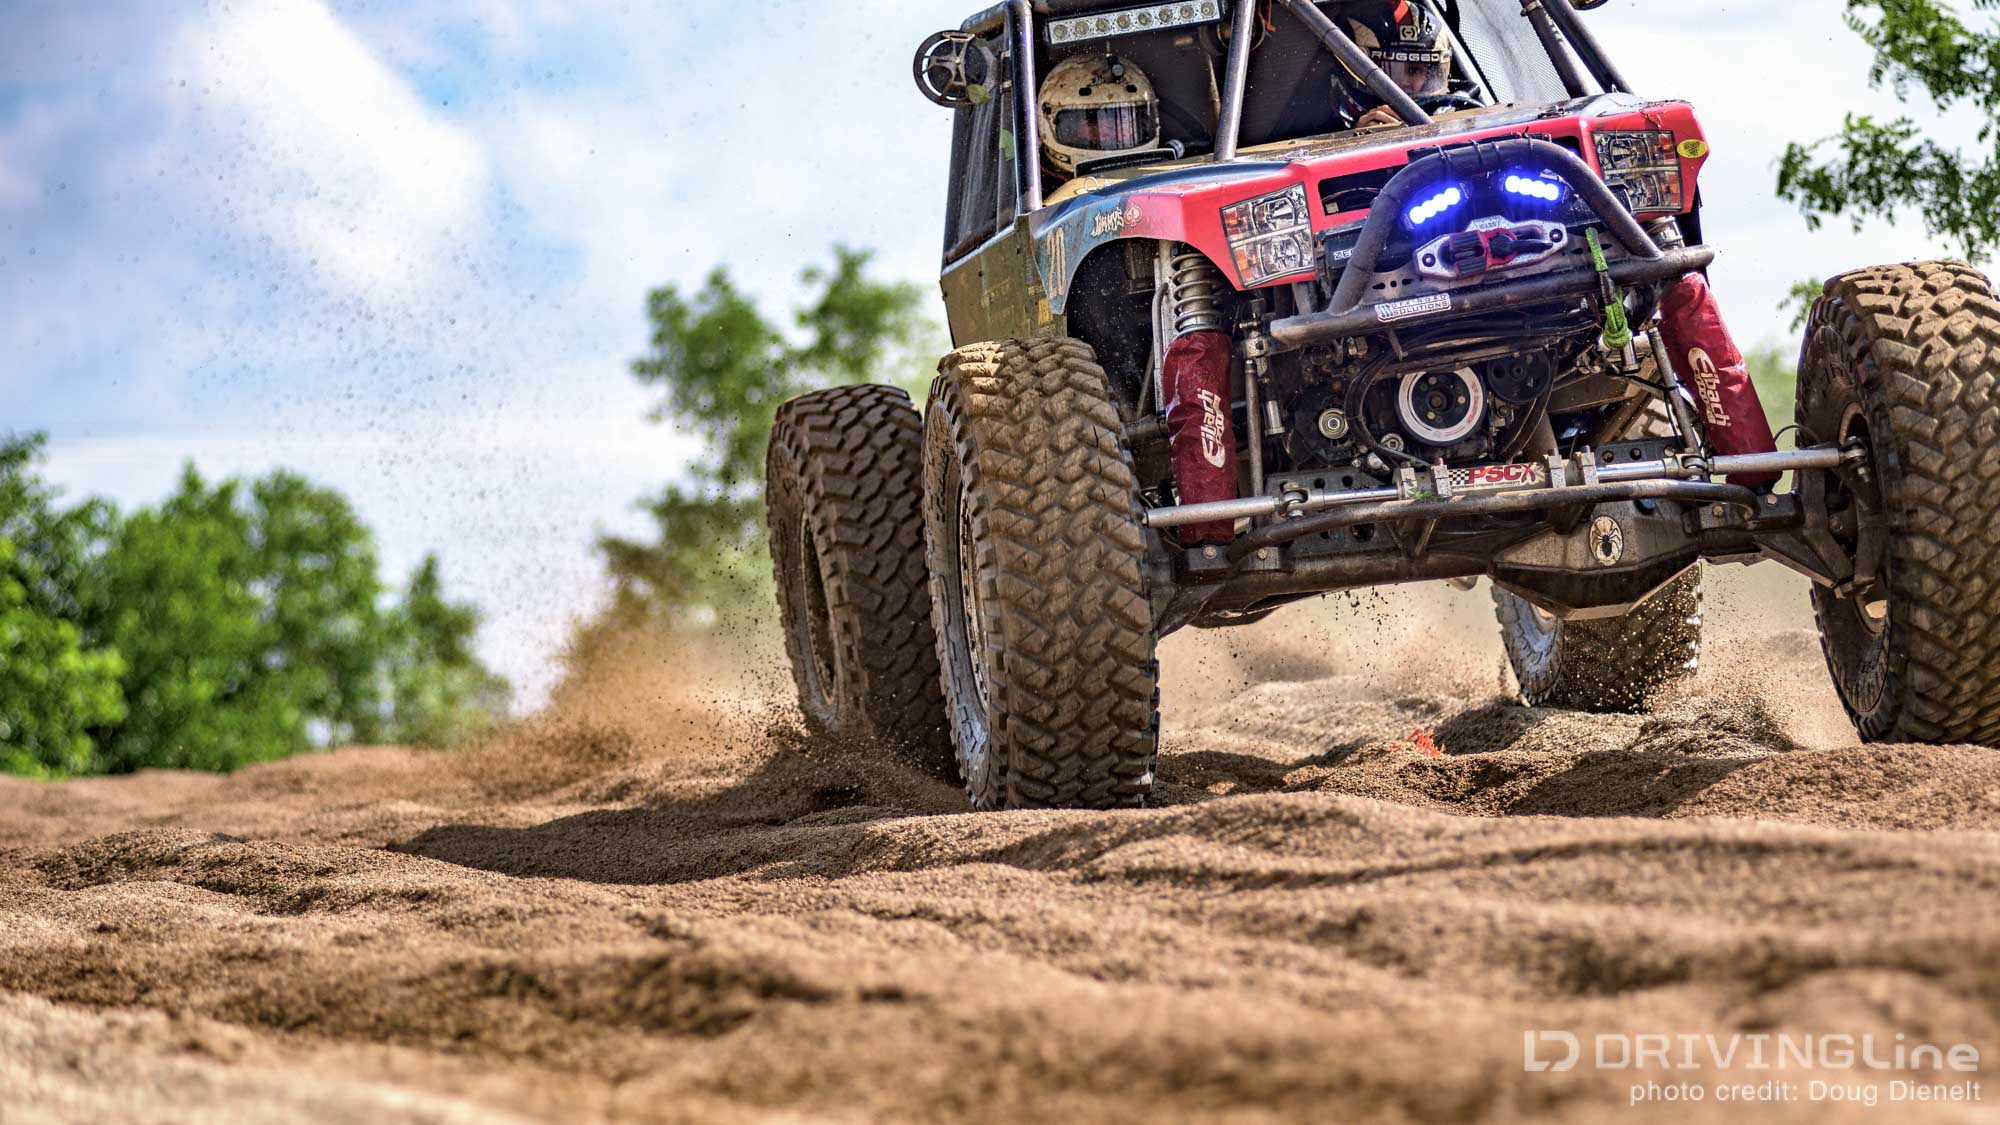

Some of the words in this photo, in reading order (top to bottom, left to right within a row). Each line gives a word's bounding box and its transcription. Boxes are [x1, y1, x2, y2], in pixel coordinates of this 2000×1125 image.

[1371, 51, 1440, 61] RUGGED
[1046, 227, 1066, 299] 20
[1393, 301, 1448, 315] SOLUTIONS
[1687, 347, 1732, 427] Eibach
[1197, 387, 1226, 468] Eibach
